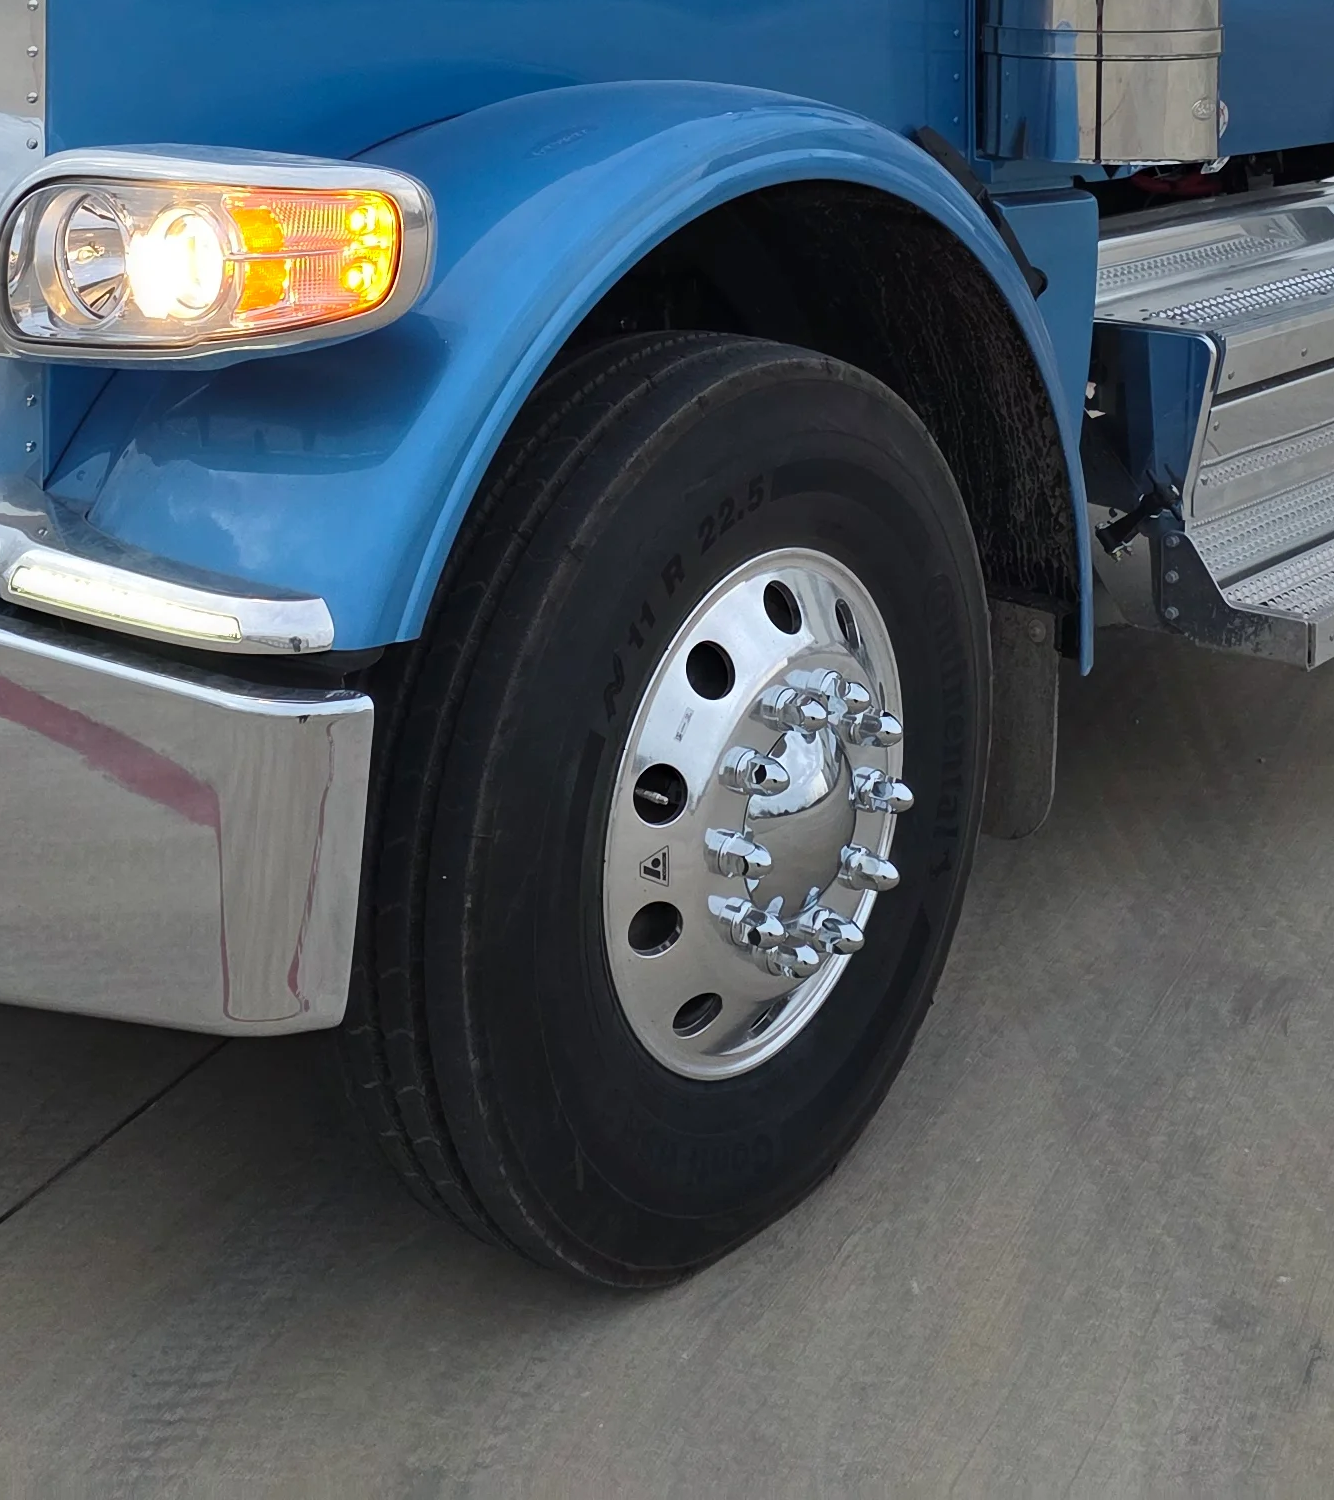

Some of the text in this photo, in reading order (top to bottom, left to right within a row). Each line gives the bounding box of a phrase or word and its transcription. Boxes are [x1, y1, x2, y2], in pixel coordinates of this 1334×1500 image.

[628, 474, 764, 649] 11 R 22.5
